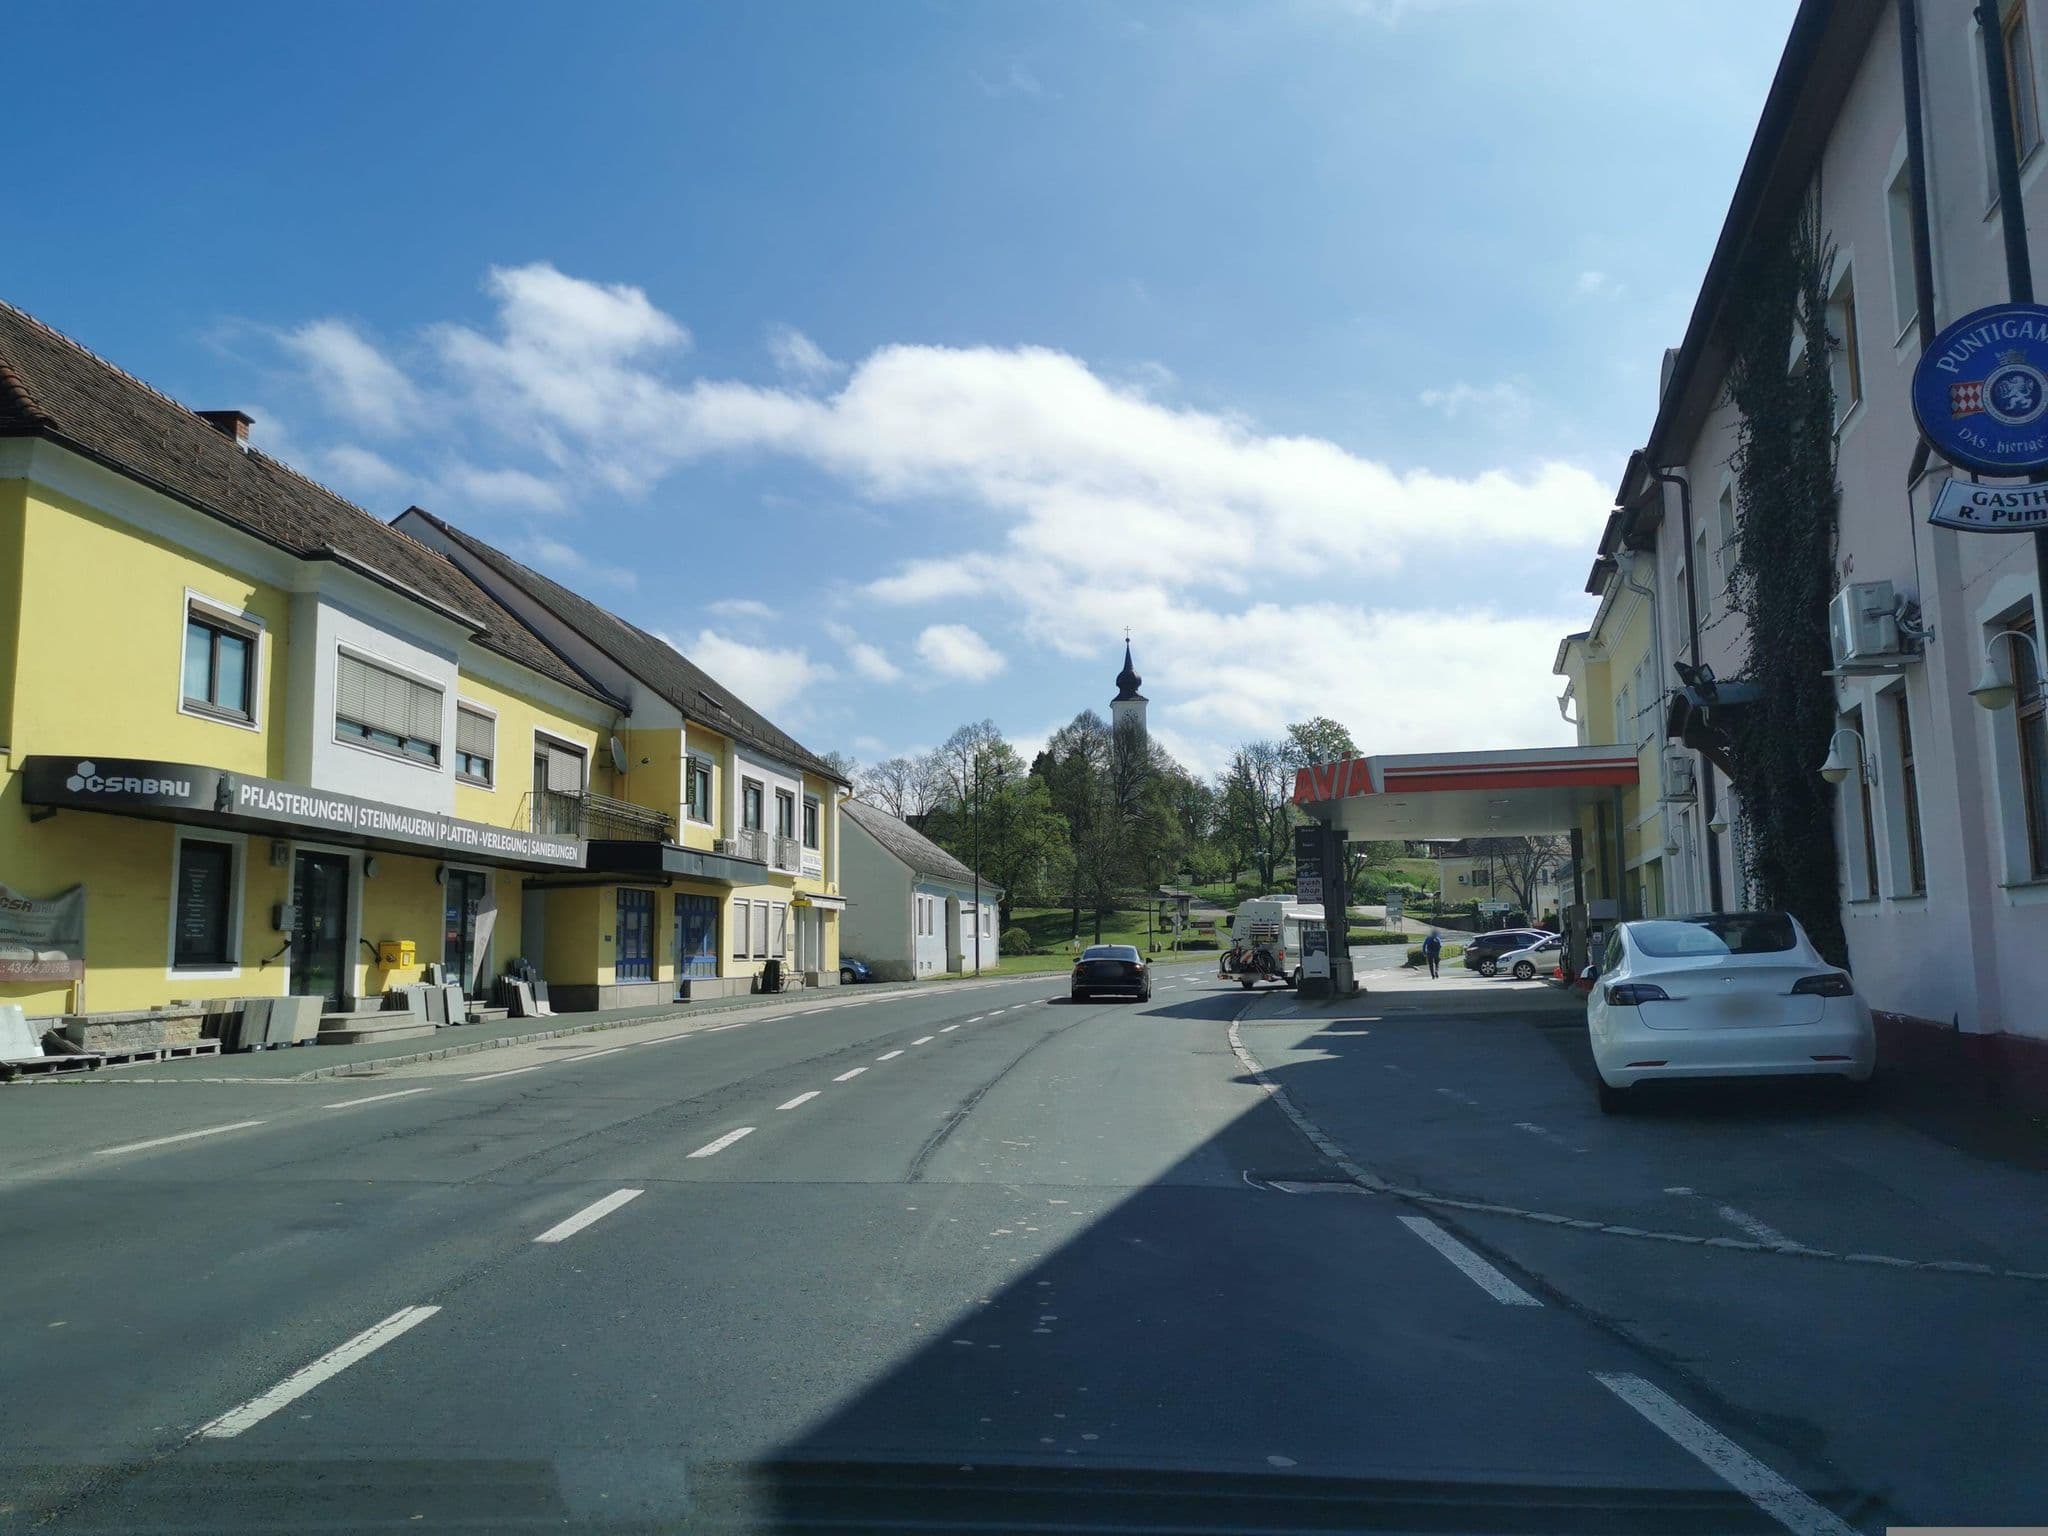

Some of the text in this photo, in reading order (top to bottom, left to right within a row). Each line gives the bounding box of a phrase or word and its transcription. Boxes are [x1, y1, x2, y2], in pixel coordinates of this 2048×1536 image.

[1958, 427, 1988, 449] DAS
[1959, 505, 1980, 521] R.
[86, 775, 191, 798] CSABAU
[1293, 758, 1375, 806] AVIA
[240, 784, 353, 823] PFLASTERUNGEN
[359, 808, 435, 838] STEINMAUERN
[531, 842, 578, 861] SANIERUNGEN
